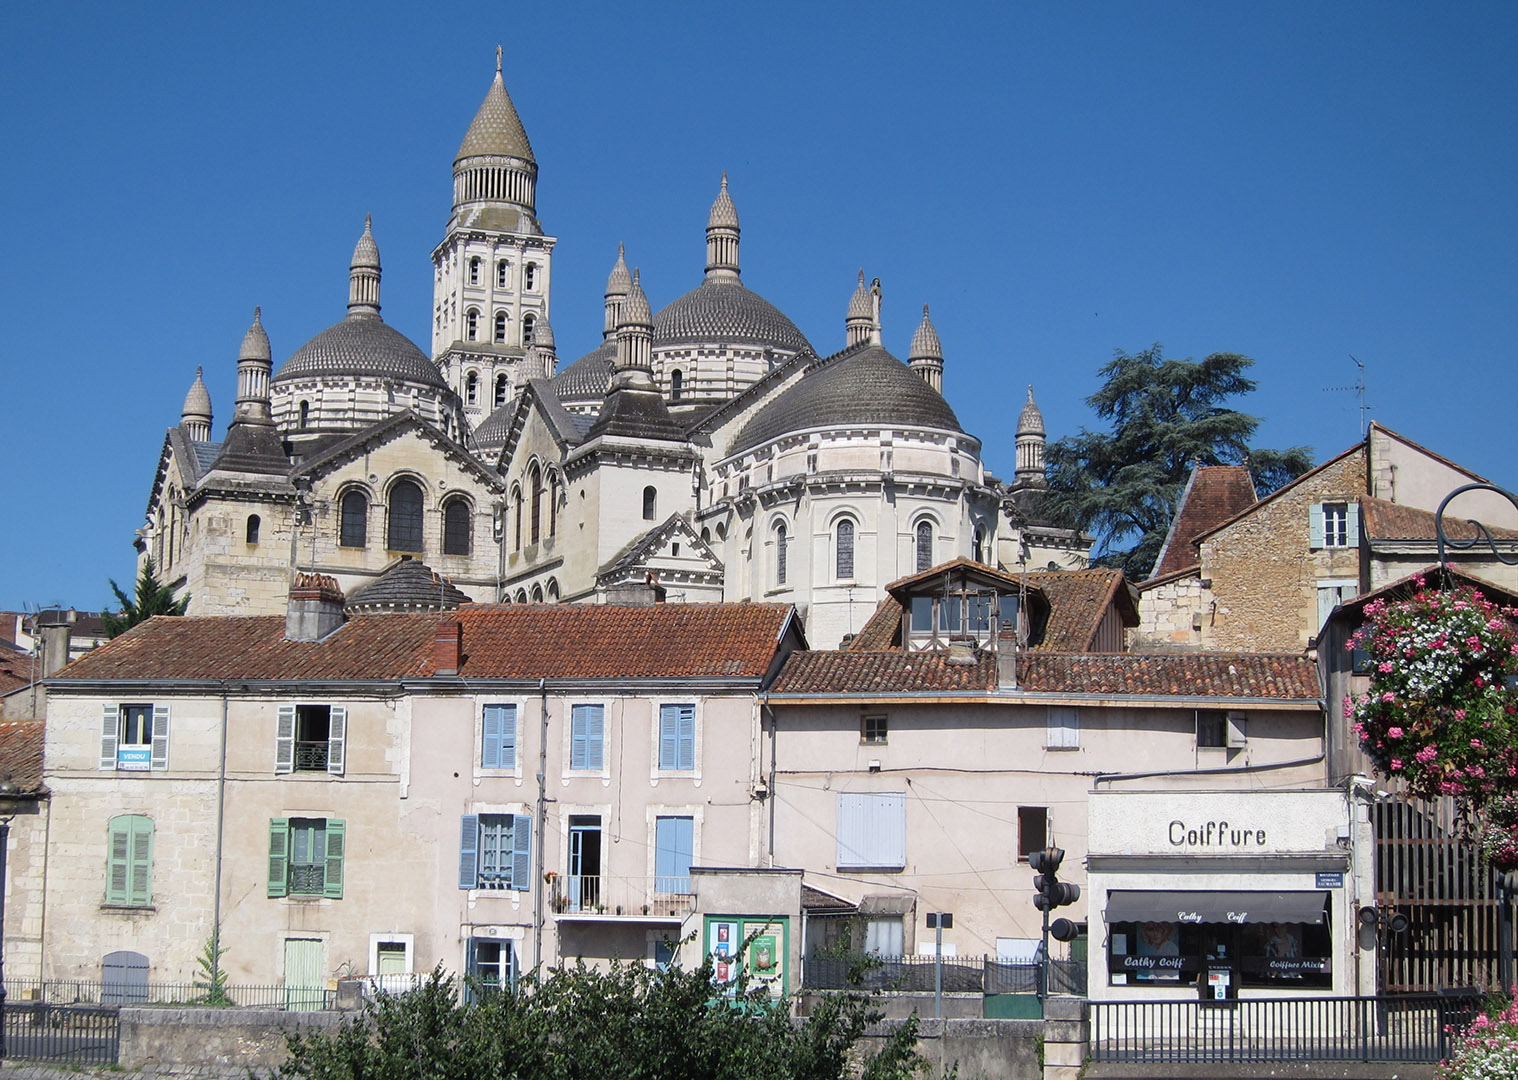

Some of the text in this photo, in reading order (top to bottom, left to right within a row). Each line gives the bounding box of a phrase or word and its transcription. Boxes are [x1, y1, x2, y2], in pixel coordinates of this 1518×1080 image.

[1168, 820, 1266, 846] Coiffure
[1178, 911, 1203, 923] Cathy
[1124, 957, 1156, 969] Cathy
[1269, 960, 1300, 969] Coiffure
